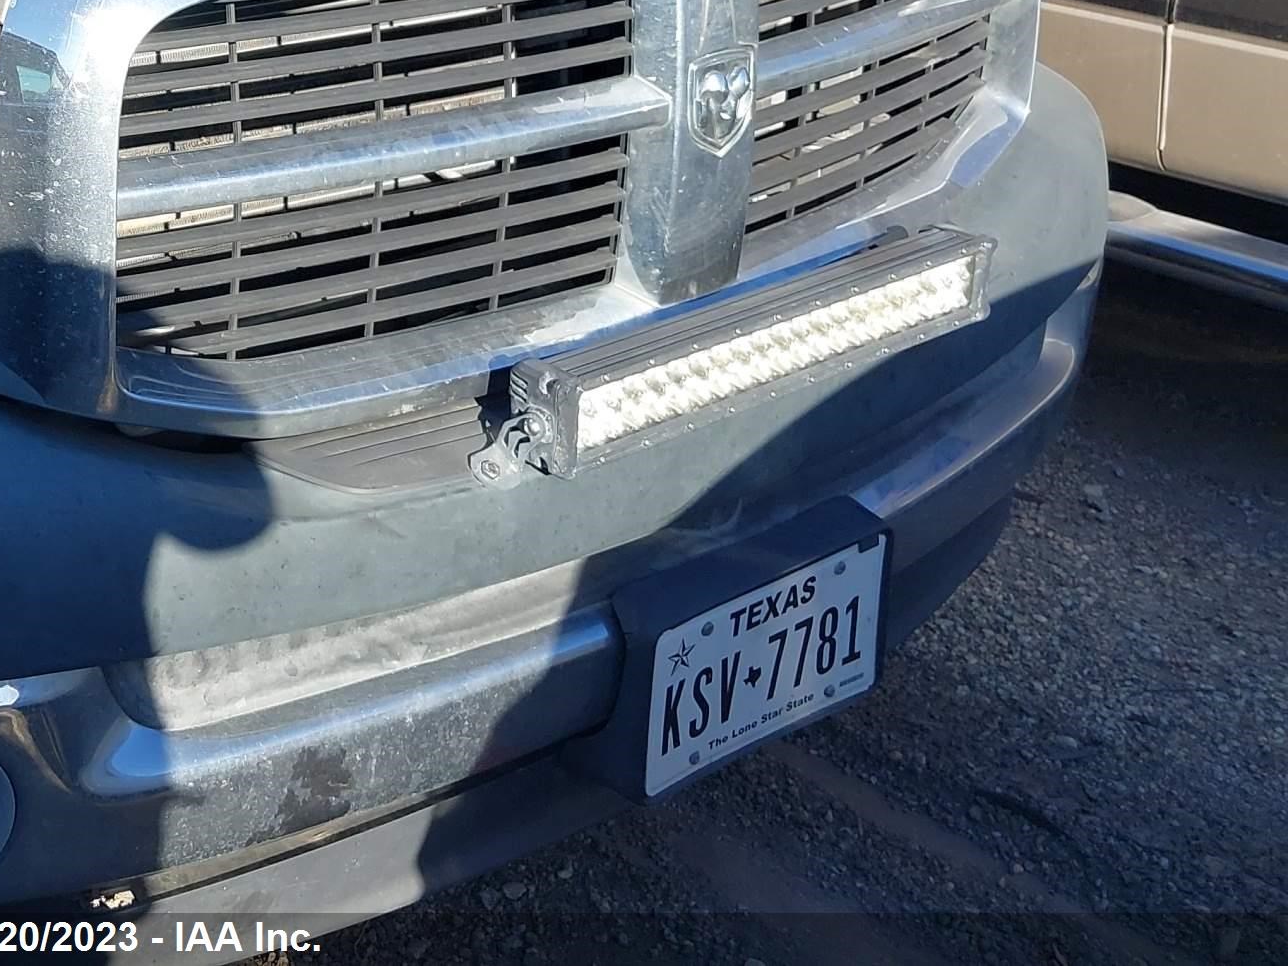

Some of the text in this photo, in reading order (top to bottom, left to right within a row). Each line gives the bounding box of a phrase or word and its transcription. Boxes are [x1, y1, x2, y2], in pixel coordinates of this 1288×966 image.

[730, 575, 817, 637] TEXAS
[661, 596, 862, 756] KSV 7781
[707, 693, 815, 750] The Lone Star State
